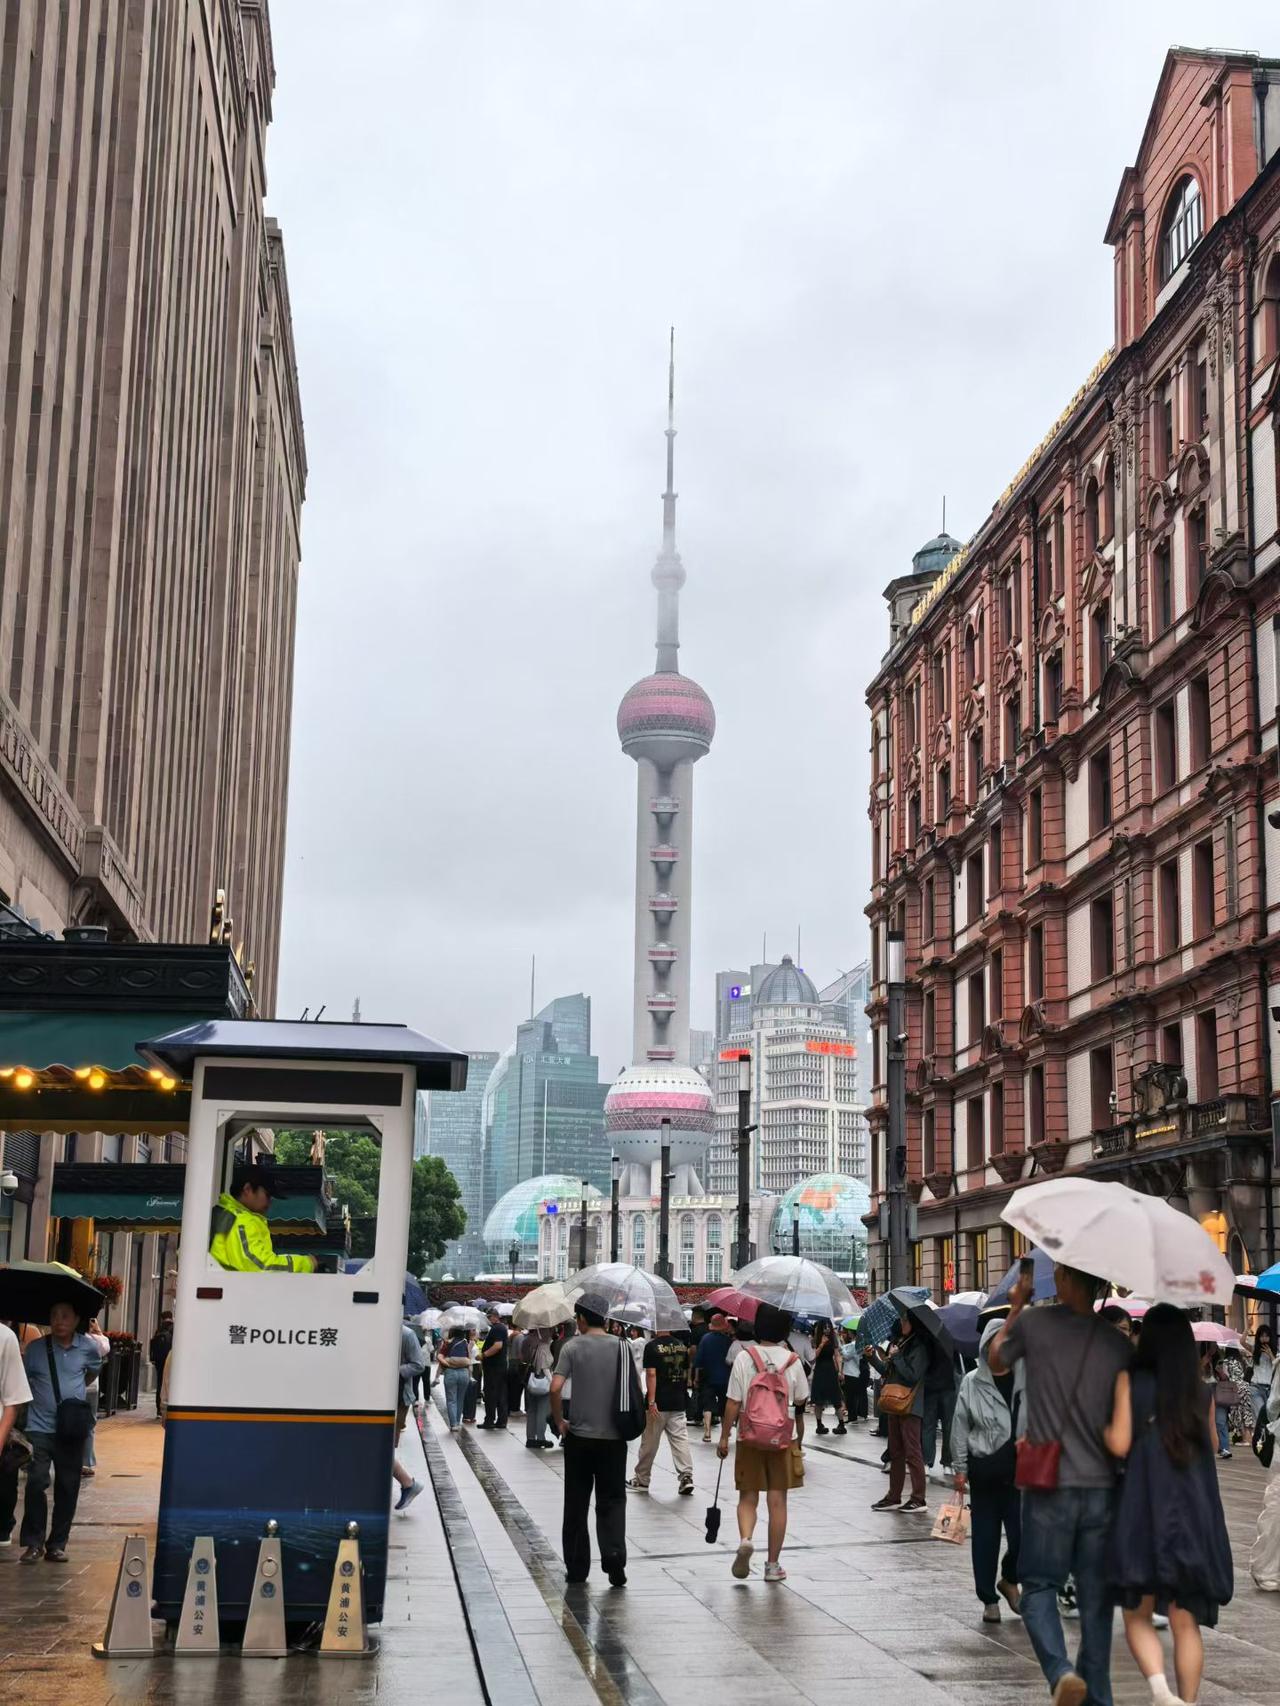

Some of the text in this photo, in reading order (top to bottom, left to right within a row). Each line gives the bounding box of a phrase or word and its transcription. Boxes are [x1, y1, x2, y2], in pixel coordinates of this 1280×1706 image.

[192, 1580, 207, 1636] 黄浦公安
[336, 1582, 352, 1637] 黄浦公安
